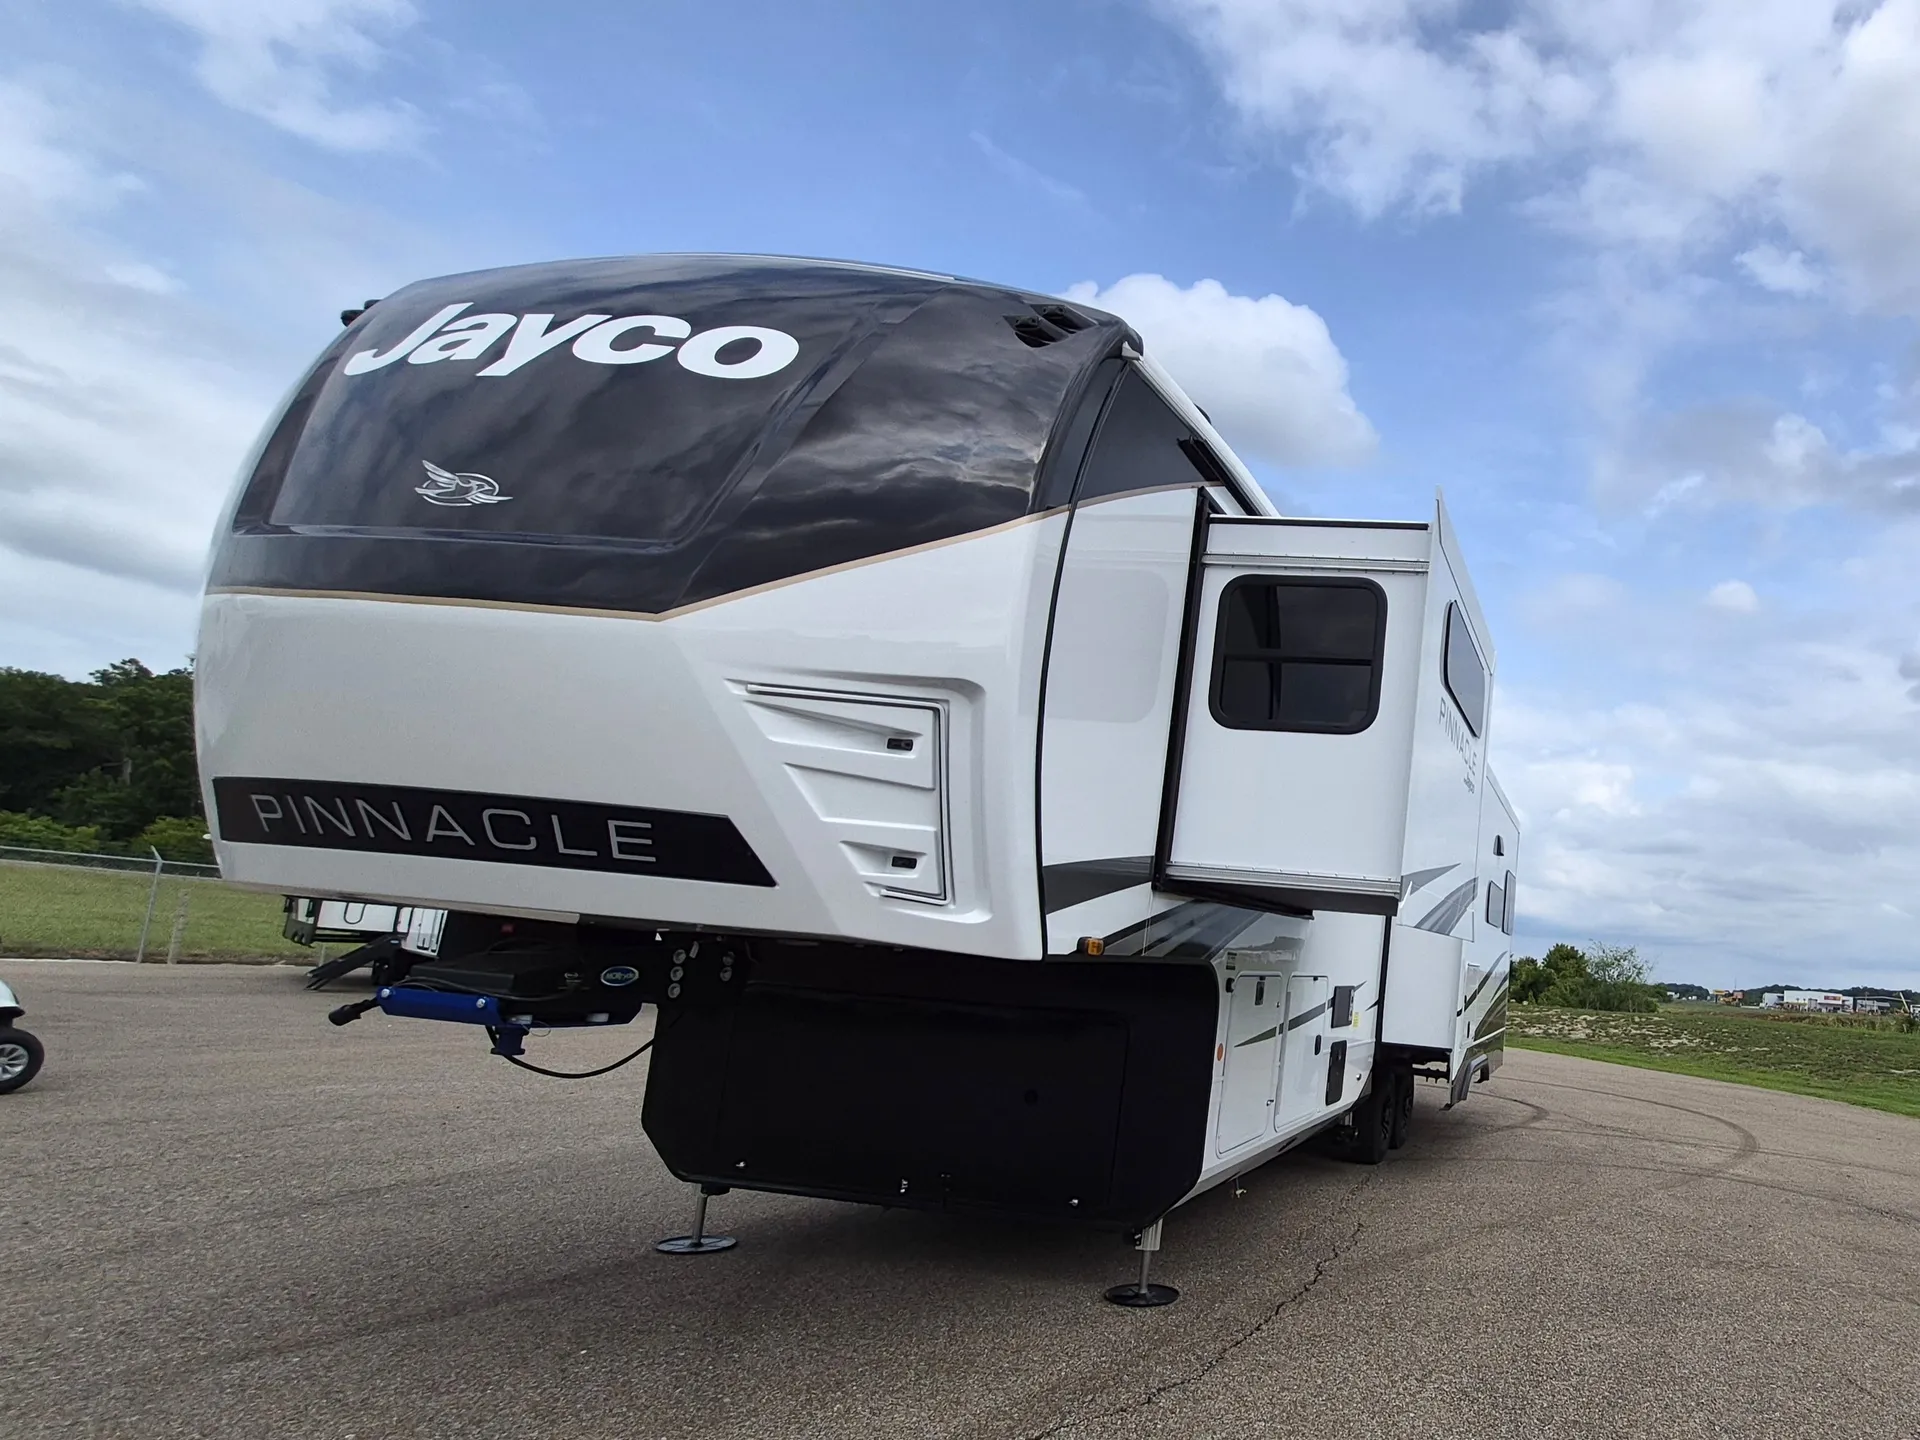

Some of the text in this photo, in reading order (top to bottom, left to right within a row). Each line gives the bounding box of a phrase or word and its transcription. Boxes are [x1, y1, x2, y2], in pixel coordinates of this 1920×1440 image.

[344, 302, 799, 379] Jayco
[1439, 697, 1477, 776] PINNACLE
[249, 794, 657, 862] PINNACLE
